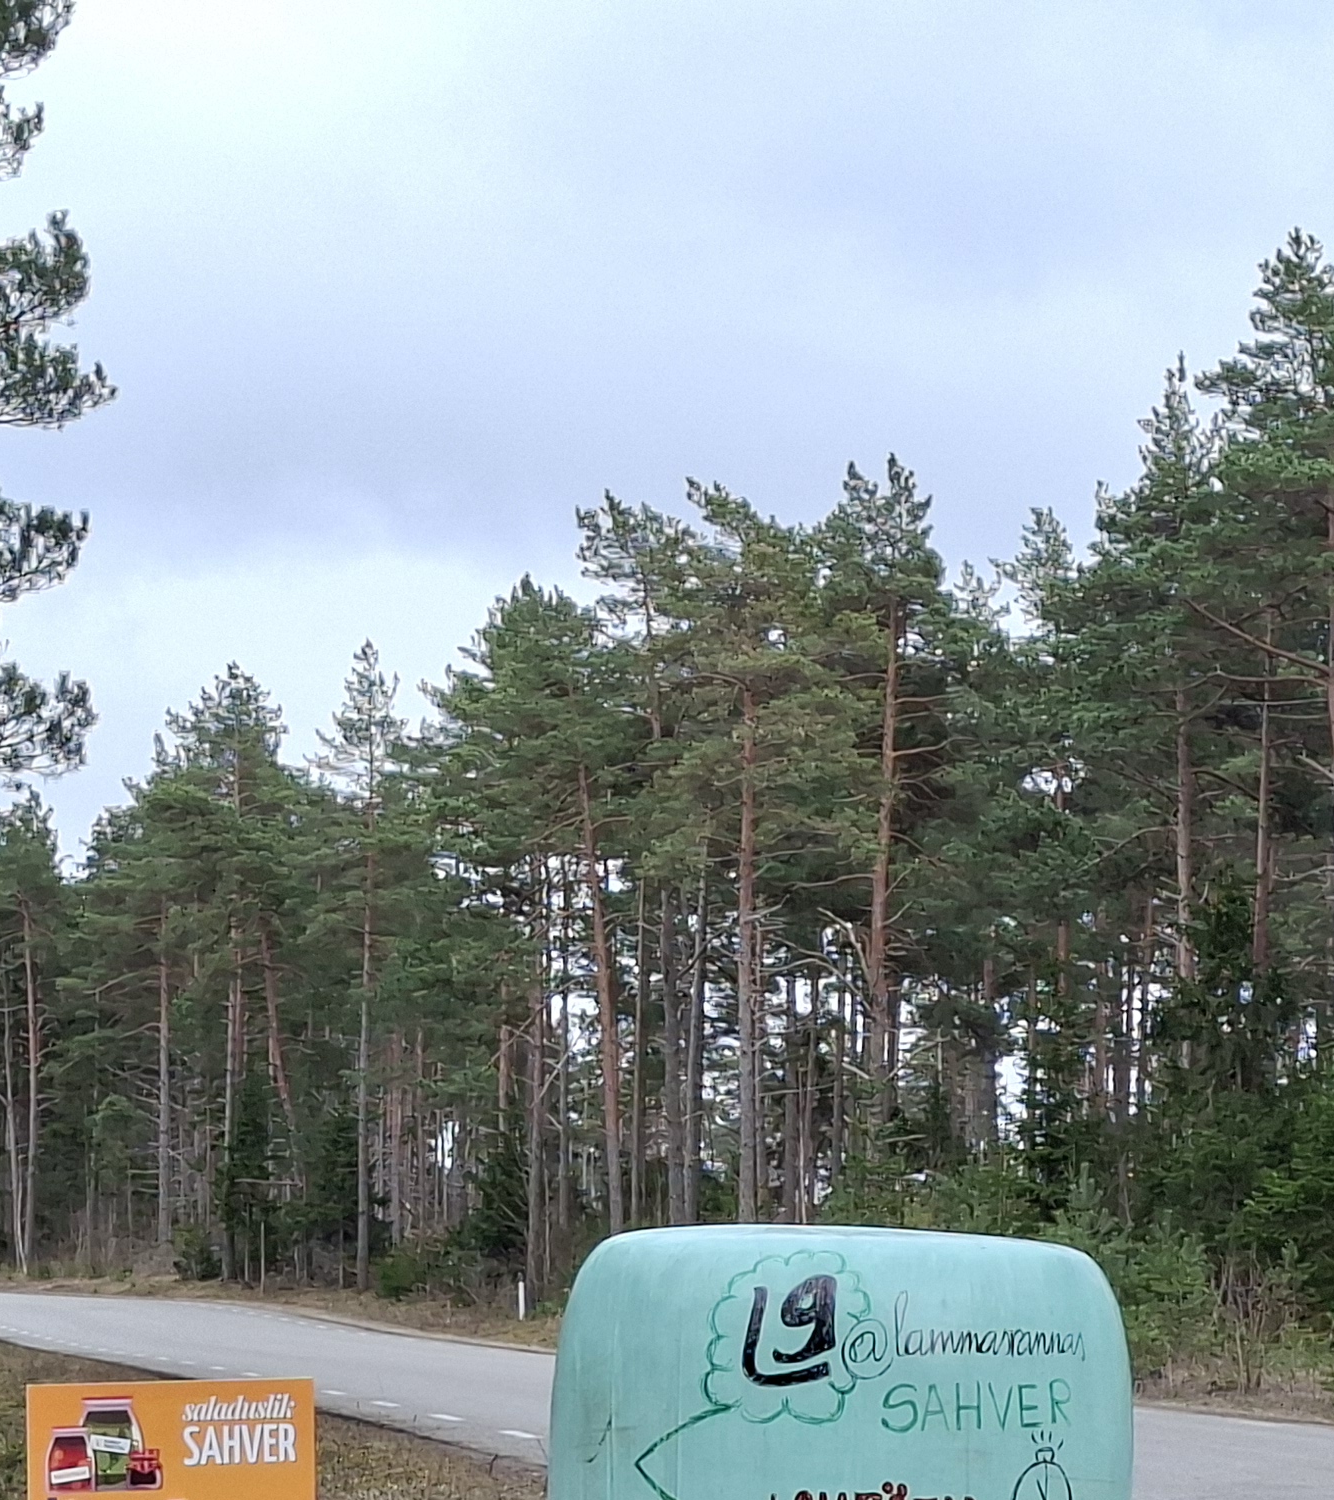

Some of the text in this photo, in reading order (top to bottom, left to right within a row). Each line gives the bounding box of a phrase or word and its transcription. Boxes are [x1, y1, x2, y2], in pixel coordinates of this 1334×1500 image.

[182, 1393, 294, 1422] saladuslik
[881, 1378, 1071, 1433] SAHVER
[183, 1423, 296, 1466] SAHVER
